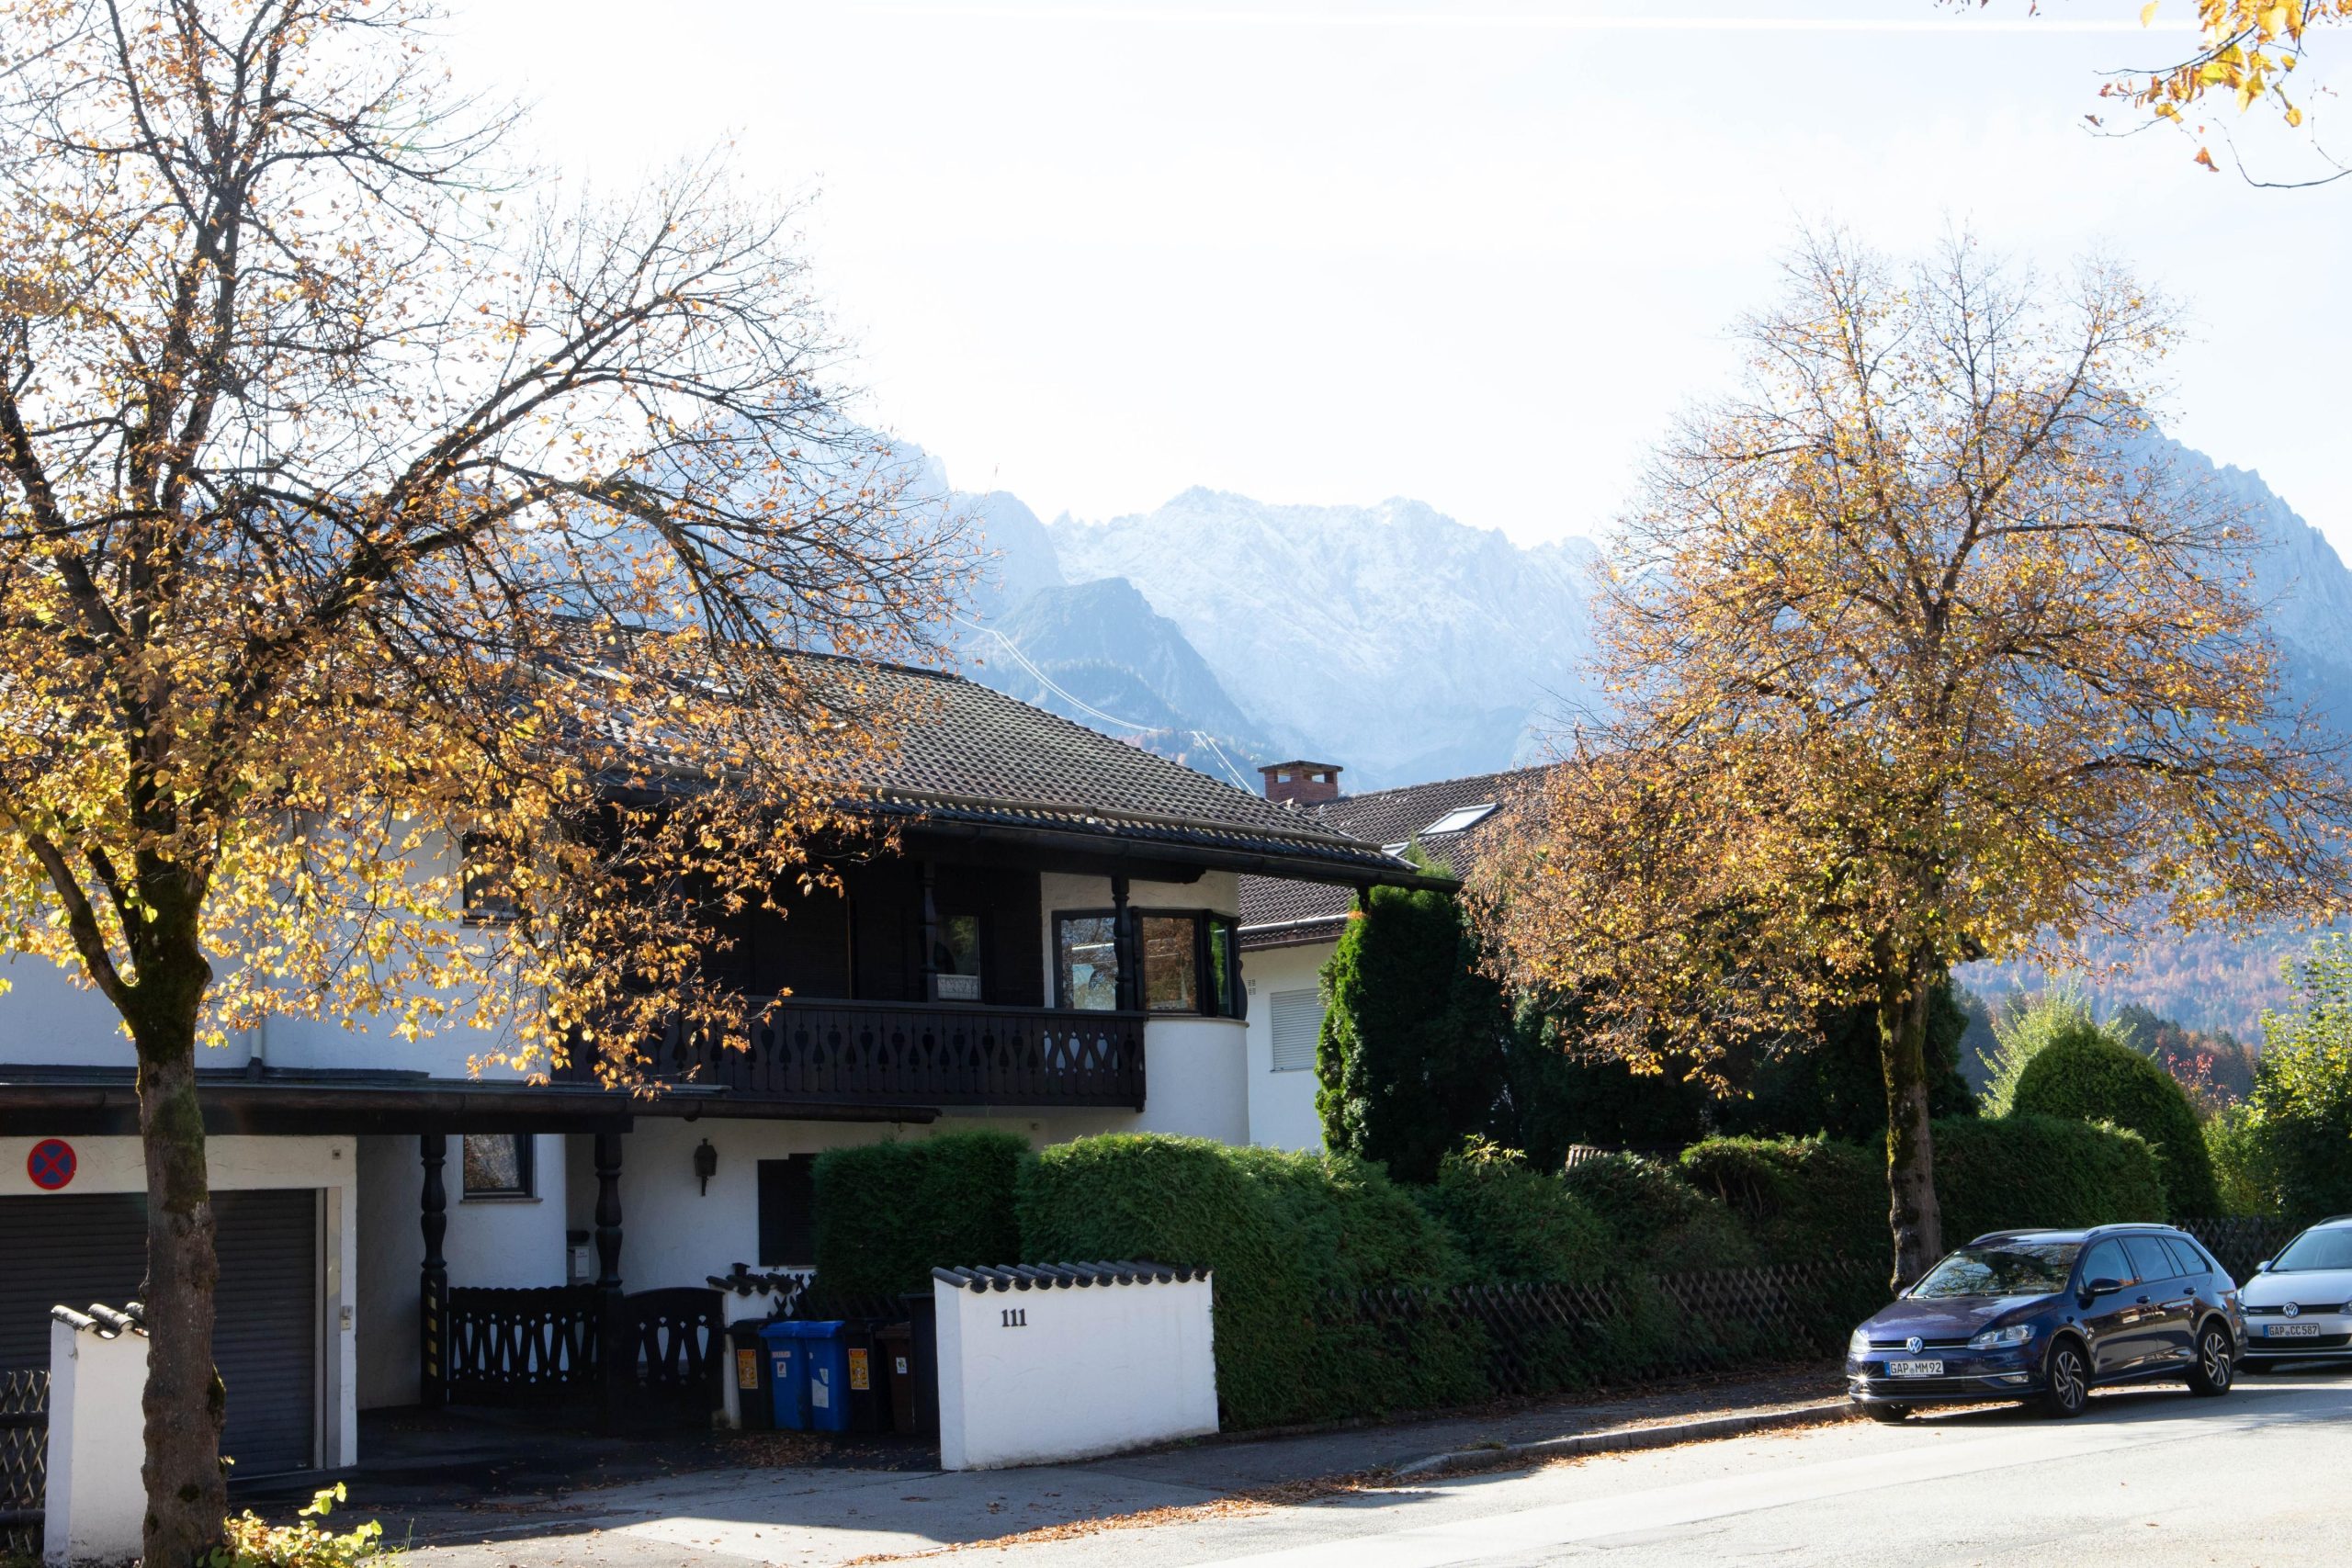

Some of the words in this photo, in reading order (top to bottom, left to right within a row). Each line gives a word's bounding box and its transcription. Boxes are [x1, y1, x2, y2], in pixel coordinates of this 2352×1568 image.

[1001, 1308, 1027, 1326] 111
[2269, 1326, 2284, 1336] GAP
[1890, 1363, 1908, 1374] GAP
